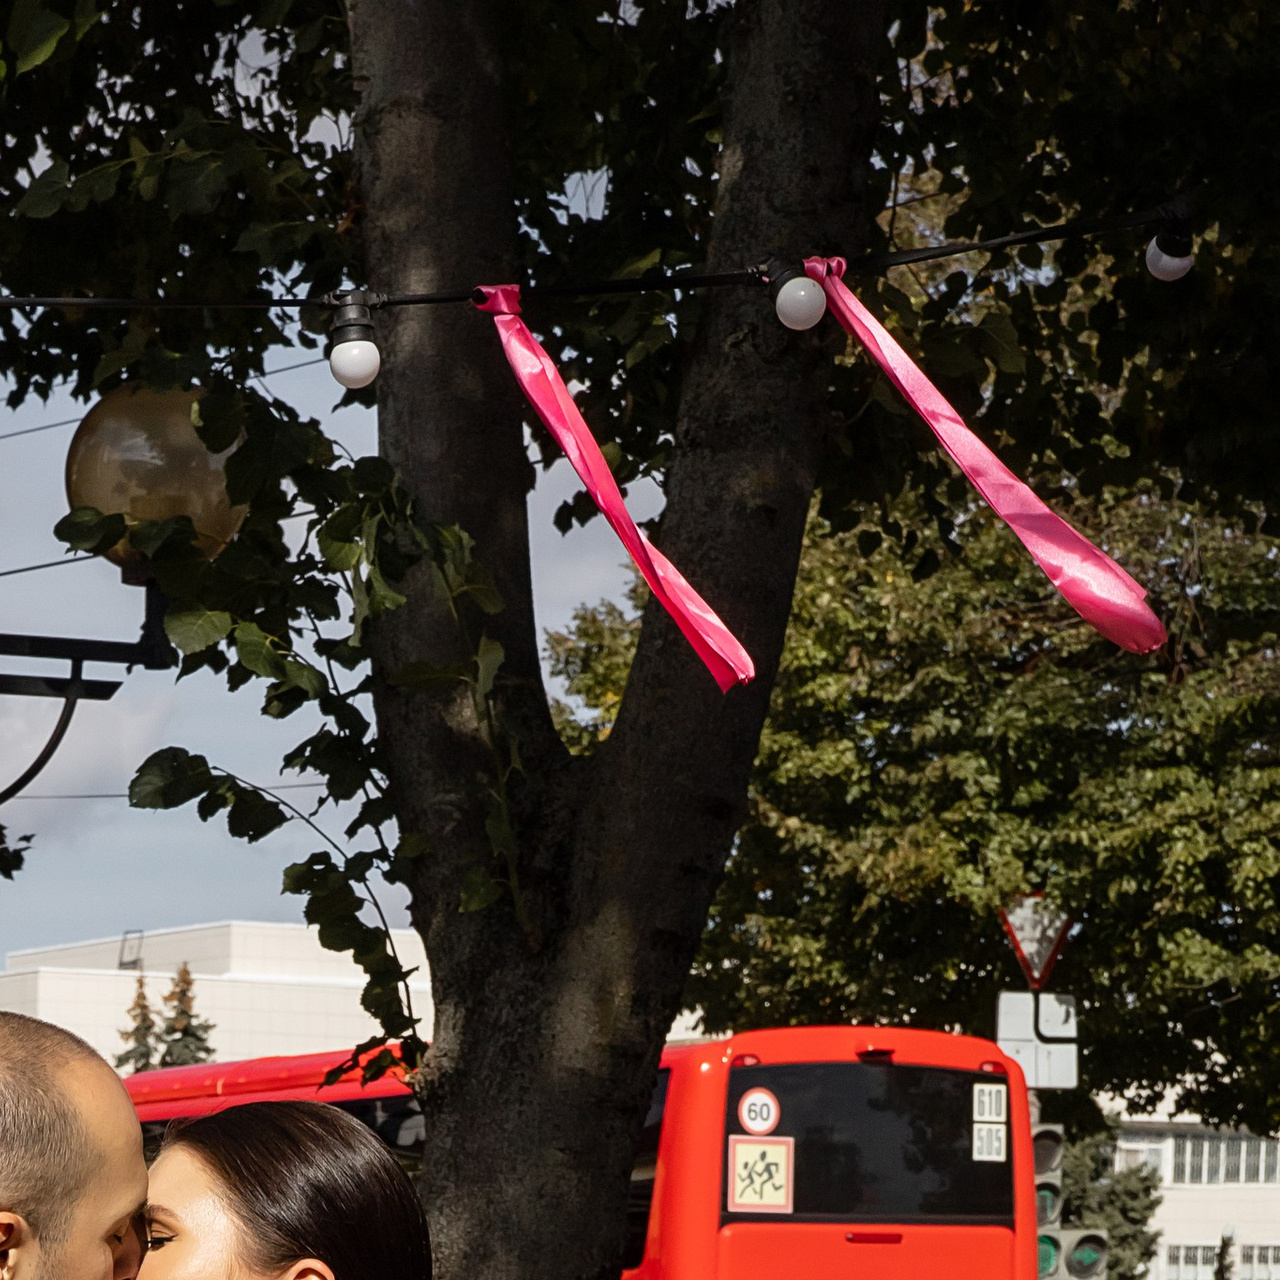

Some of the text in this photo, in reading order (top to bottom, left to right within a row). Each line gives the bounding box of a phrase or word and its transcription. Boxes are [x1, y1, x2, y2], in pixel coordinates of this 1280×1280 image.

[747, 1102, 771, 1121] 60
[977, 1088, 1002, 1117] 610
[977, 1127, 1002, 1156] 505
